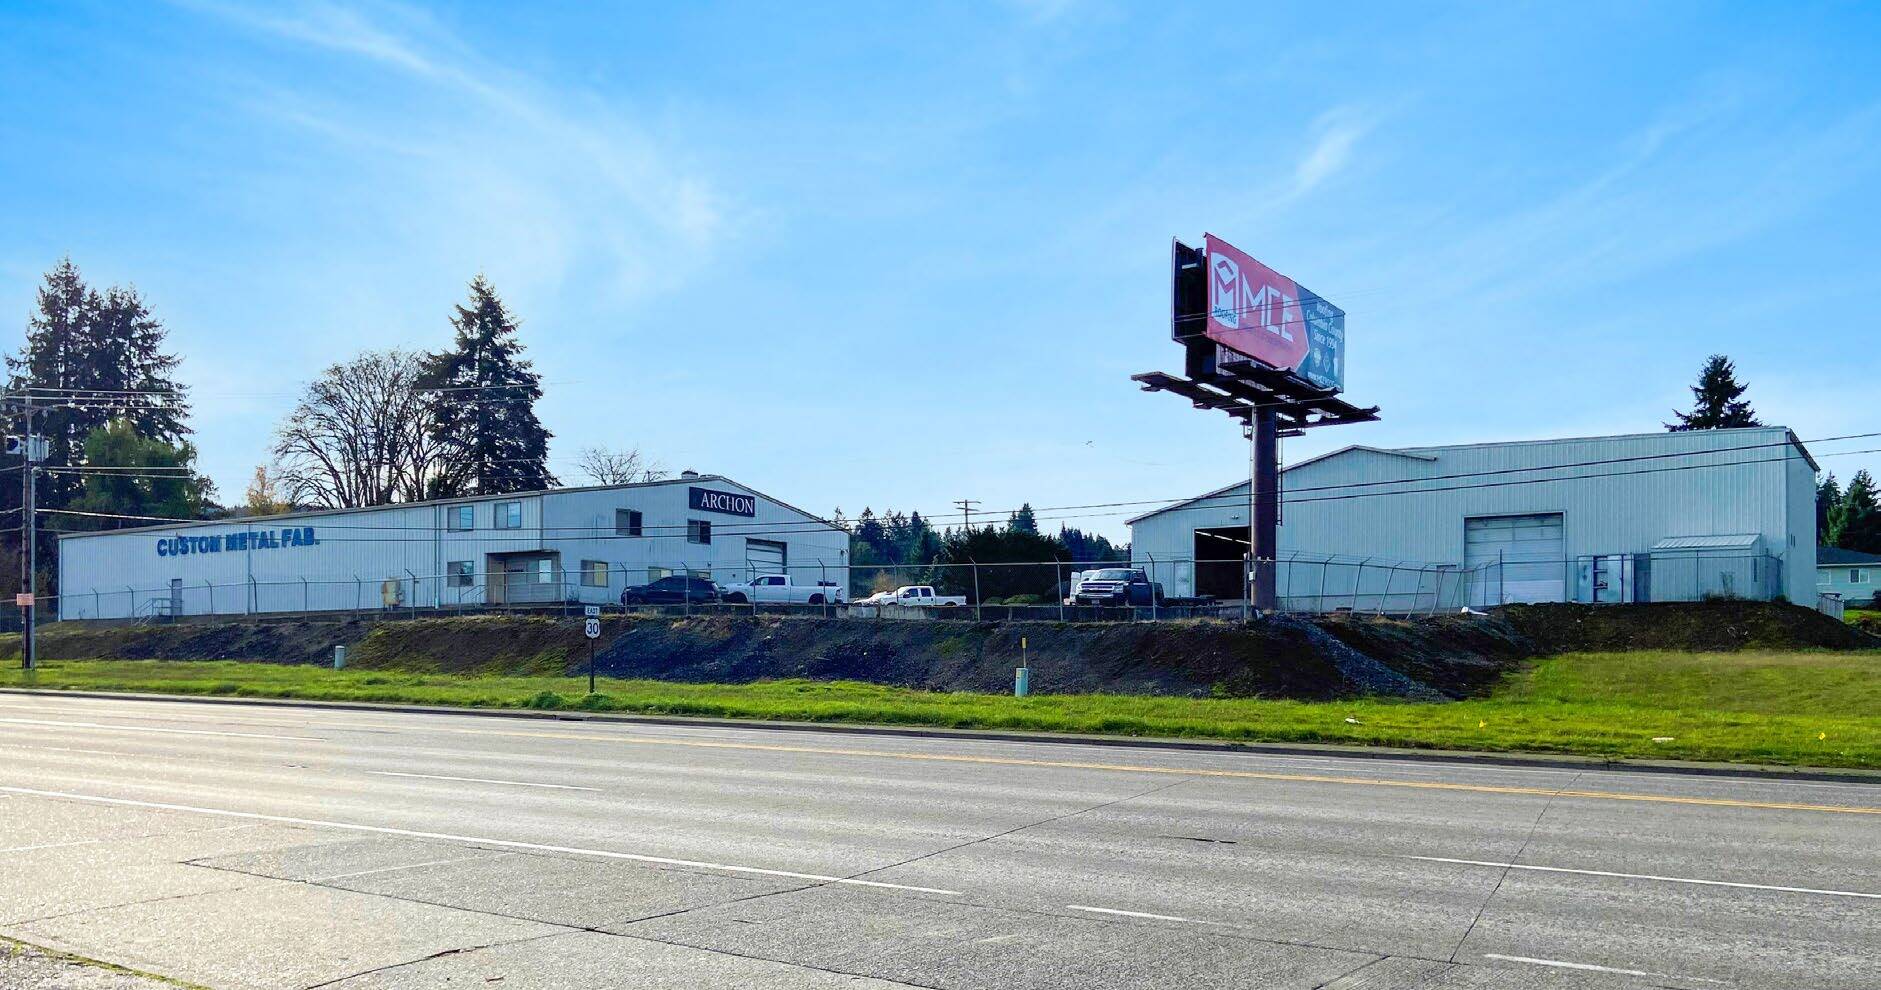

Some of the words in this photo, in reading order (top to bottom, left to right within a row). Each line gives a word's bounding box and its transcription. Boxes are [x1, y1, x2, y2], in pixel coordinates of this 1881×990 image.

[1242, 271, 1294, 343] MCE
[701, 492, 754, 514] ARCHON
[157, 534, 222, 557] CUSTOM
[225, 530, 279, 552] METAL
[281, 527, 321, 548] FAB.
[587, 622, 599, 635] 30
